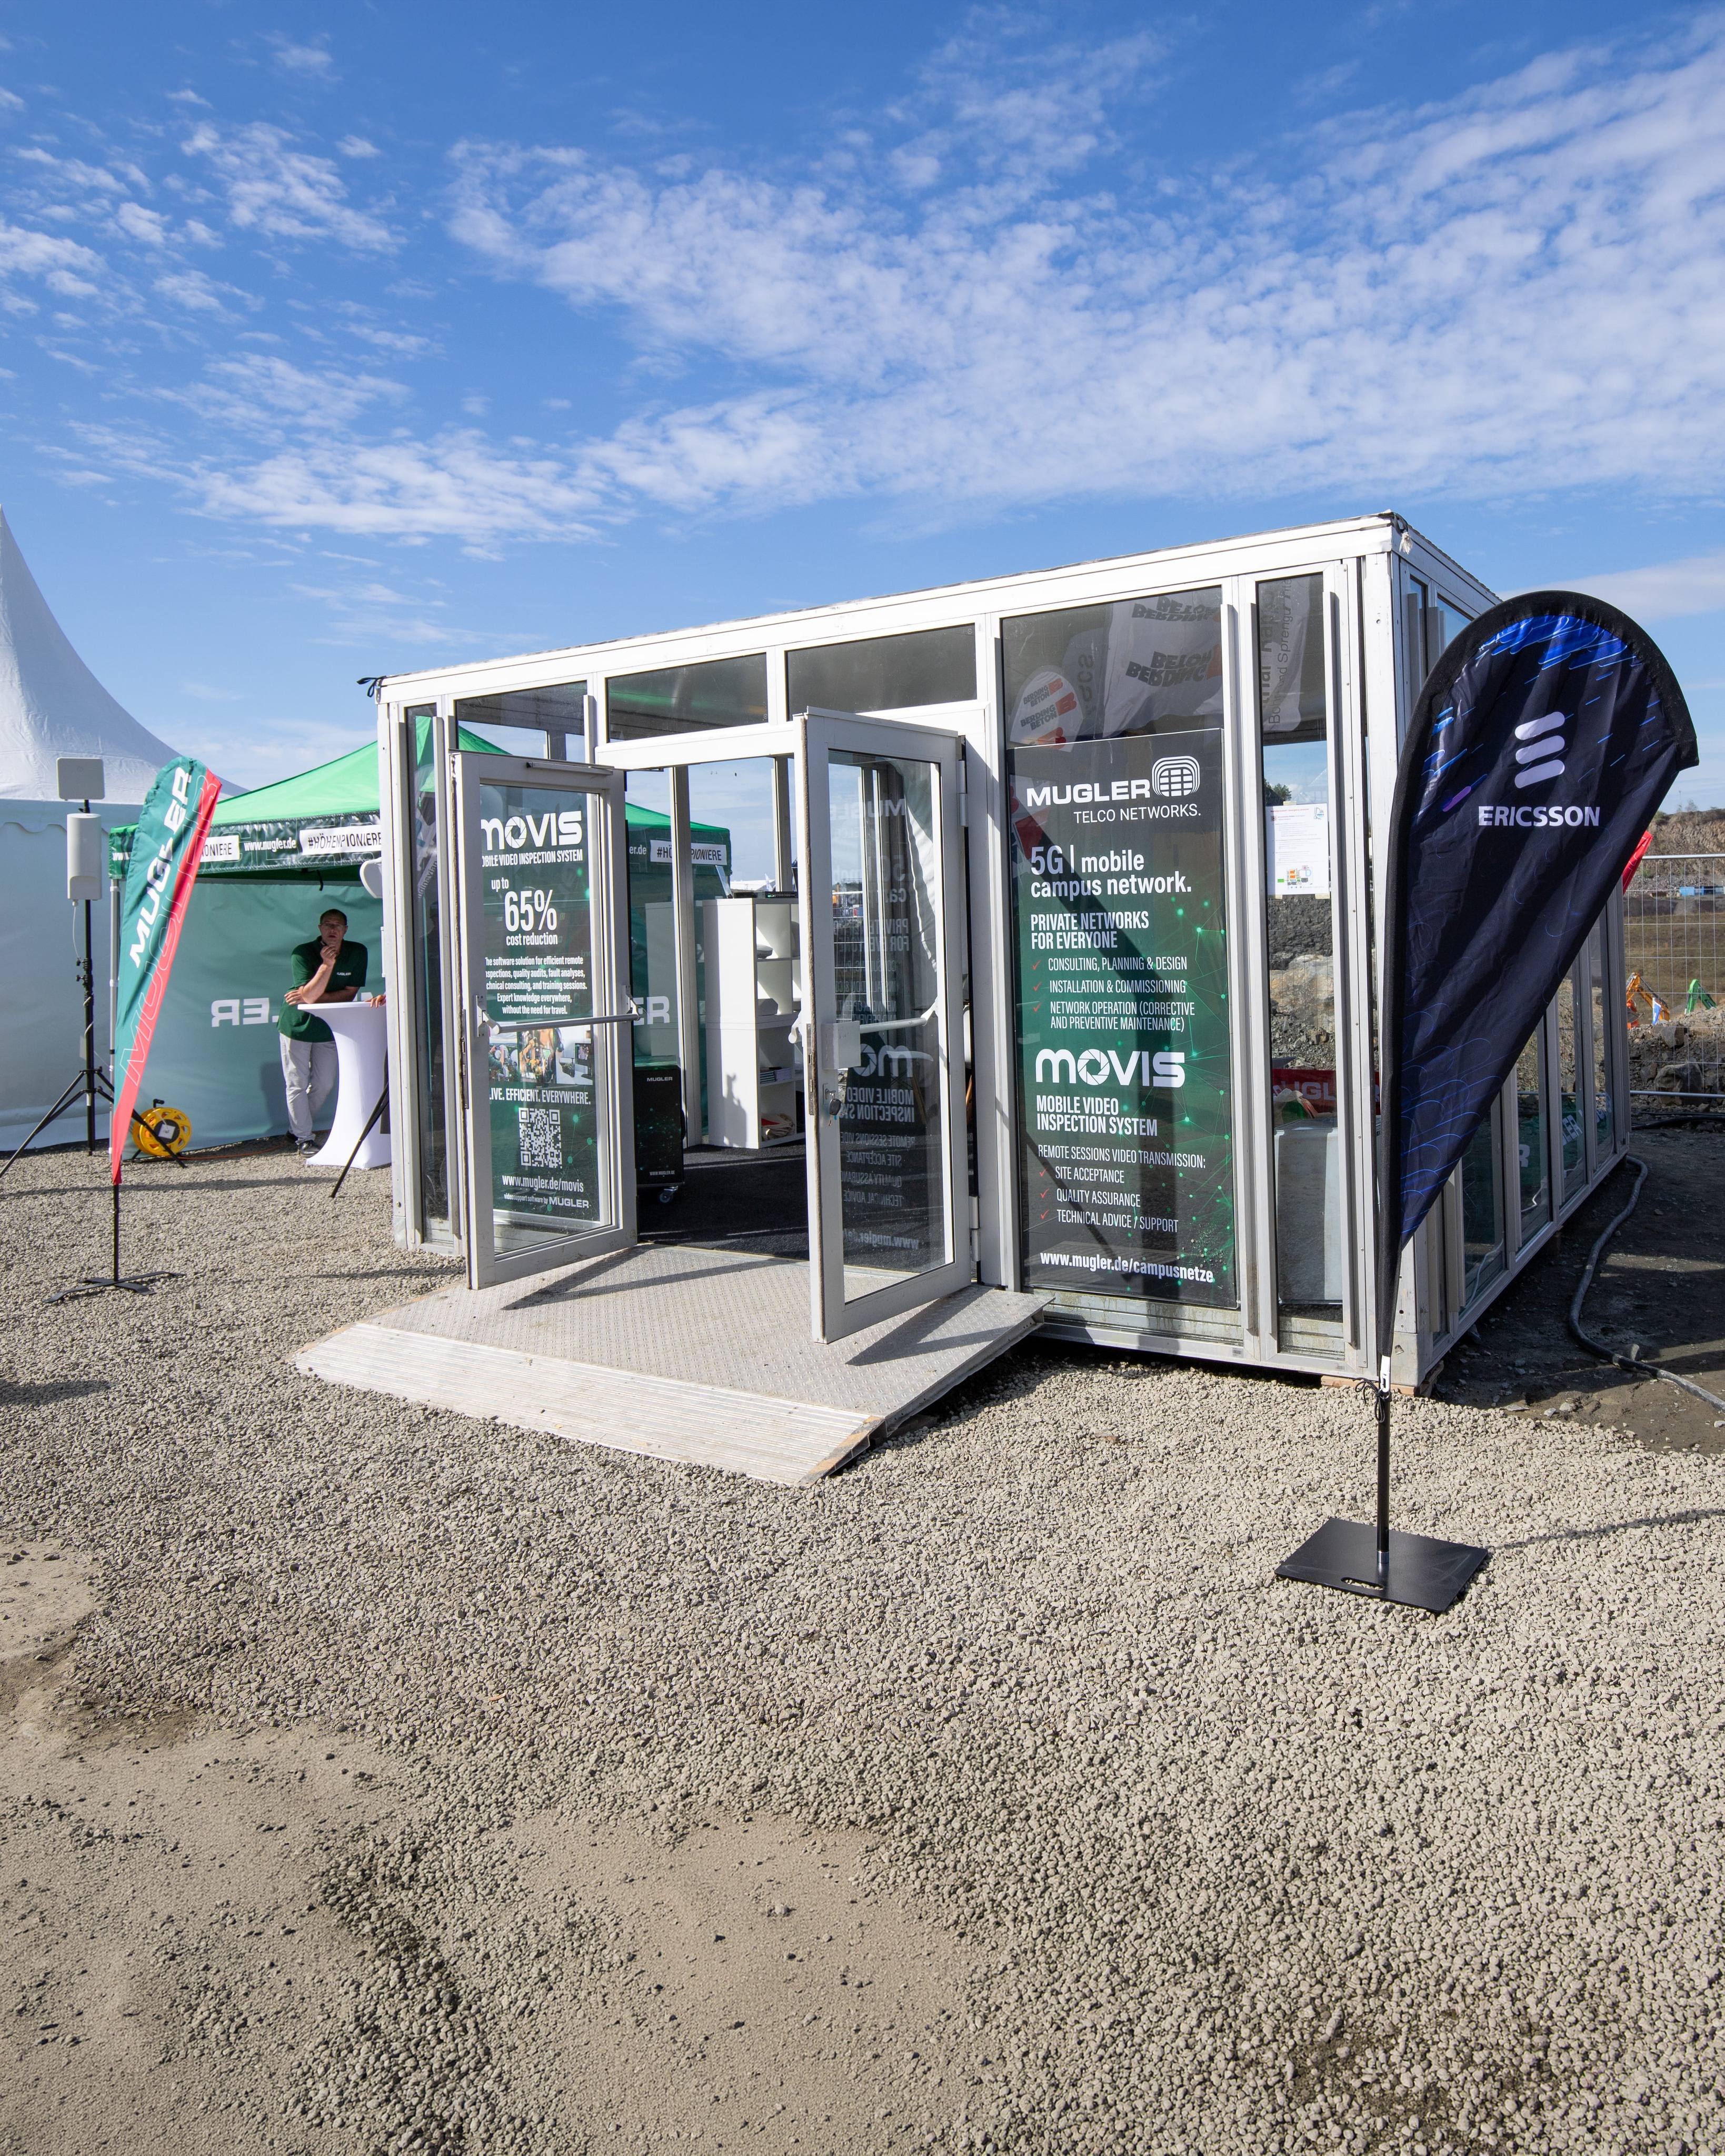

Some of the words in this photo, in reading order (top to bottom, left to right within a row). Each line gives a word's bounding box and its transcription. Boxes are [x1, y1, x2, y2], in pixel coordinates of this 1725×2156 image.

[1020, 705, 1055, 727] BERDING
[1030, 712, 1057, 731] BETON
[1026, 778, 1151, 807] MUGLER
[1074, 809, 1115, 824] TELCO
[1120, 803, 1201, 821] NETWORKS.
[1478, 806, 1600, 826] ERICSSON
[498, 853, 518, 866] VIDEO
[519, 850, 556, 865] INSPECTION
[557, 849, 583, 862] SYSTEM
[1031, 845, 1063, 876] 5G
[1081, 849, 1144, 873] mobile
[491, 879, 500, 892] up
[501, 877, 509, 889] to
[1031, 877, 1102, 902] campus
[1107, 871, 1192, 895] network.
[504, 890, 557, 932] 65%
[1031, 913, 1078, 931] PRIVATE
[1081, 911, 1149, 930] NETWORKS
[506, 933, 522, 946] cost
[523, 932, 558, 945] reduction
[1031, 932, 1053, 950] FOR
[1056, 931, 1118, 949] EVERYONE
[493, 956, 515, 965] software
[515, 956, 535, 965] solution
[543, 956, 564, 965] efficient
[565, 956, 583, 965] remote
[1048, 957, 1100, 972] CONSULTING,
[1102, 957, 1144, 971] PLANNING
[1146, 956, 1154, 970] &
[1156, 956, 1187, 970] DESIGN
[513, 968, 530, 980] quality
[531, 968, 548, 978] audits,
[549, 968, 560, 977] fault
[561, 968, 585, 979] analyses,
[505, 981, 532, 991] consulting,
[533, 981, 542, 990] and
[542, 981, 563, 991] training
[563, 981, 587, 990] sessions.
[1050, 980, 1104, 994] INSTALLATION
[1106, 980, 1113, 993] &
[1115, 980, 1186, 993] COMMISSIONING
[497, 993, 513, 1003] Expert
[514, 993, 540, 1004] knowledge
[541, 993, 572, 1004] everywhere,
[502, 1005, 521, 1015] without
[530, 1005, 543, 1014] need
[551, 1005, 567, 1014] travel.
[1050, 1001, 1090, 1015] NETWORK
[1092, 1002, 1137, 1015] OPERATION
[1139, 1001, 1195, 1016] (CORRECTIVE
[1051, 1016, 1068, 1029] AND
[1070, 1016, 1118, 1030] PREVENTIVE
[1121, 1016, 1184, 1032] MAINTENANCE)
[505, 1088, 540, 1102] EFFICIENT.
[541, 1090, 591, 1105] EVERYWHERE.
[1036, 1095, 1080, 1114] MOBILE
[1083, 1096, 1119, 1115] VIDEO
[1037, 1113, 1106, 1133] INSPECTION
[1109, 1117, 1158, 1136] SYSTEM
[1038, 1144, 1070, 1159] REMOTE
[1071, 1146, 1110, 1161] SESSIONS
[1112, 1149, 1136, 1163] VIDEO
[1139, 1150, 1206, 1169] TRANSMISSION:
[1055, 1166, 1072, 1180] SITE
[1073, 1167, 1124, 1183] ACCEPTANCE
[502, 1175, 584, 1193] www.mugler.de/movis
[543, 1196, 548, 1205] by
[549, 1196, 589, 1209] MUGLER
[1056, 1188, 1090, 1203] QUALITY
[1092, 1190, 1141, 1207] ASSURANCE
[1056, 1209, 1100, 1225] TECHNICAL
[1102, 1212, 1132, 1228] ADVICE
[1133, 1216, 1138, 1229] /
[1140, 1216, 1179, 1233] SUPPORT
[1040, 1252, 1213, 1283] www.mugler.de/campusnetze
